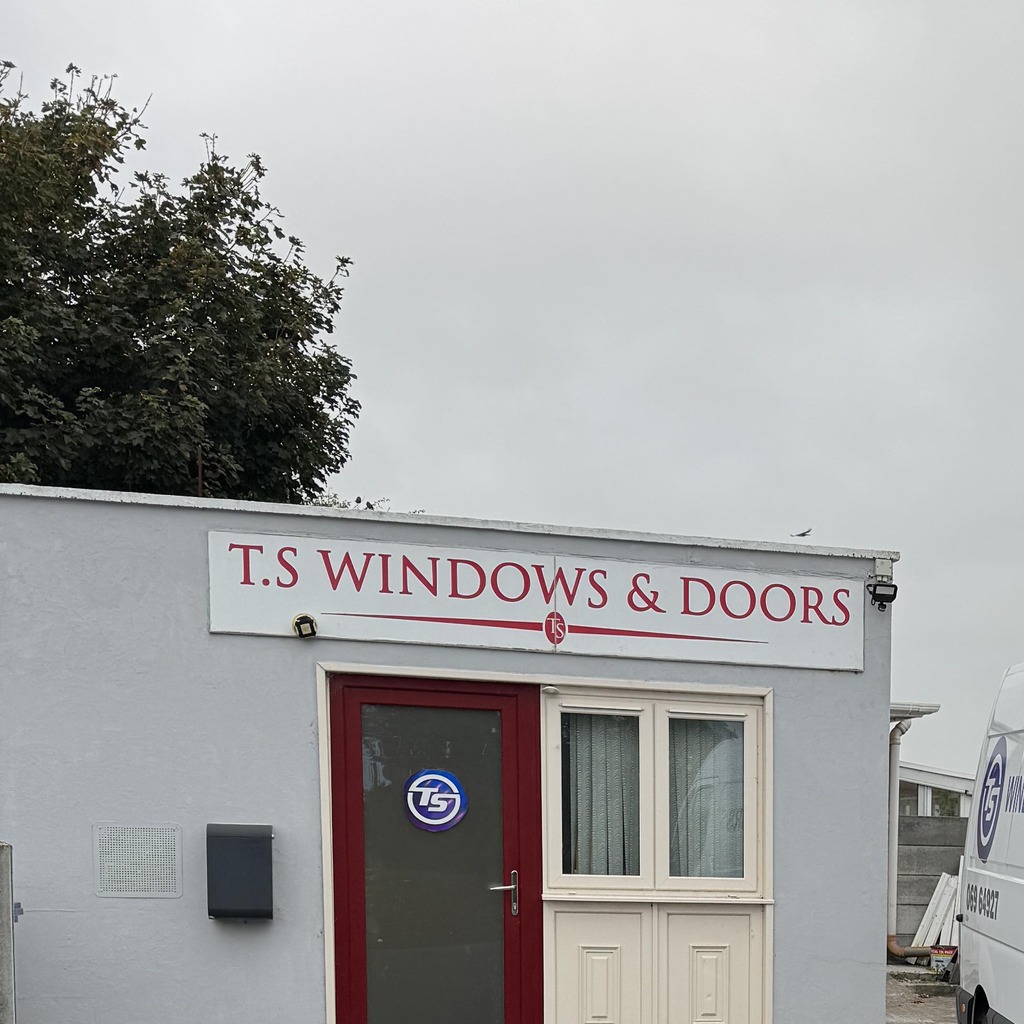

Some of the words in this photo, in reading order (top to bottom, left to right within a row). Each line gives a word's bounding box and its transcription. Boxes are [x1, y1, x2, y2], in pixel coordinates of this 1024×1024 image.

[228, 543, 299, 588] T.S
[317, 550, 608, 608] WINDOWS
[627, 572, 667, 613] &
[680, 577, 851, 627] DOORS
[966, 883, 978, 913] 069
[979, 886, 1000, 921] 64927
